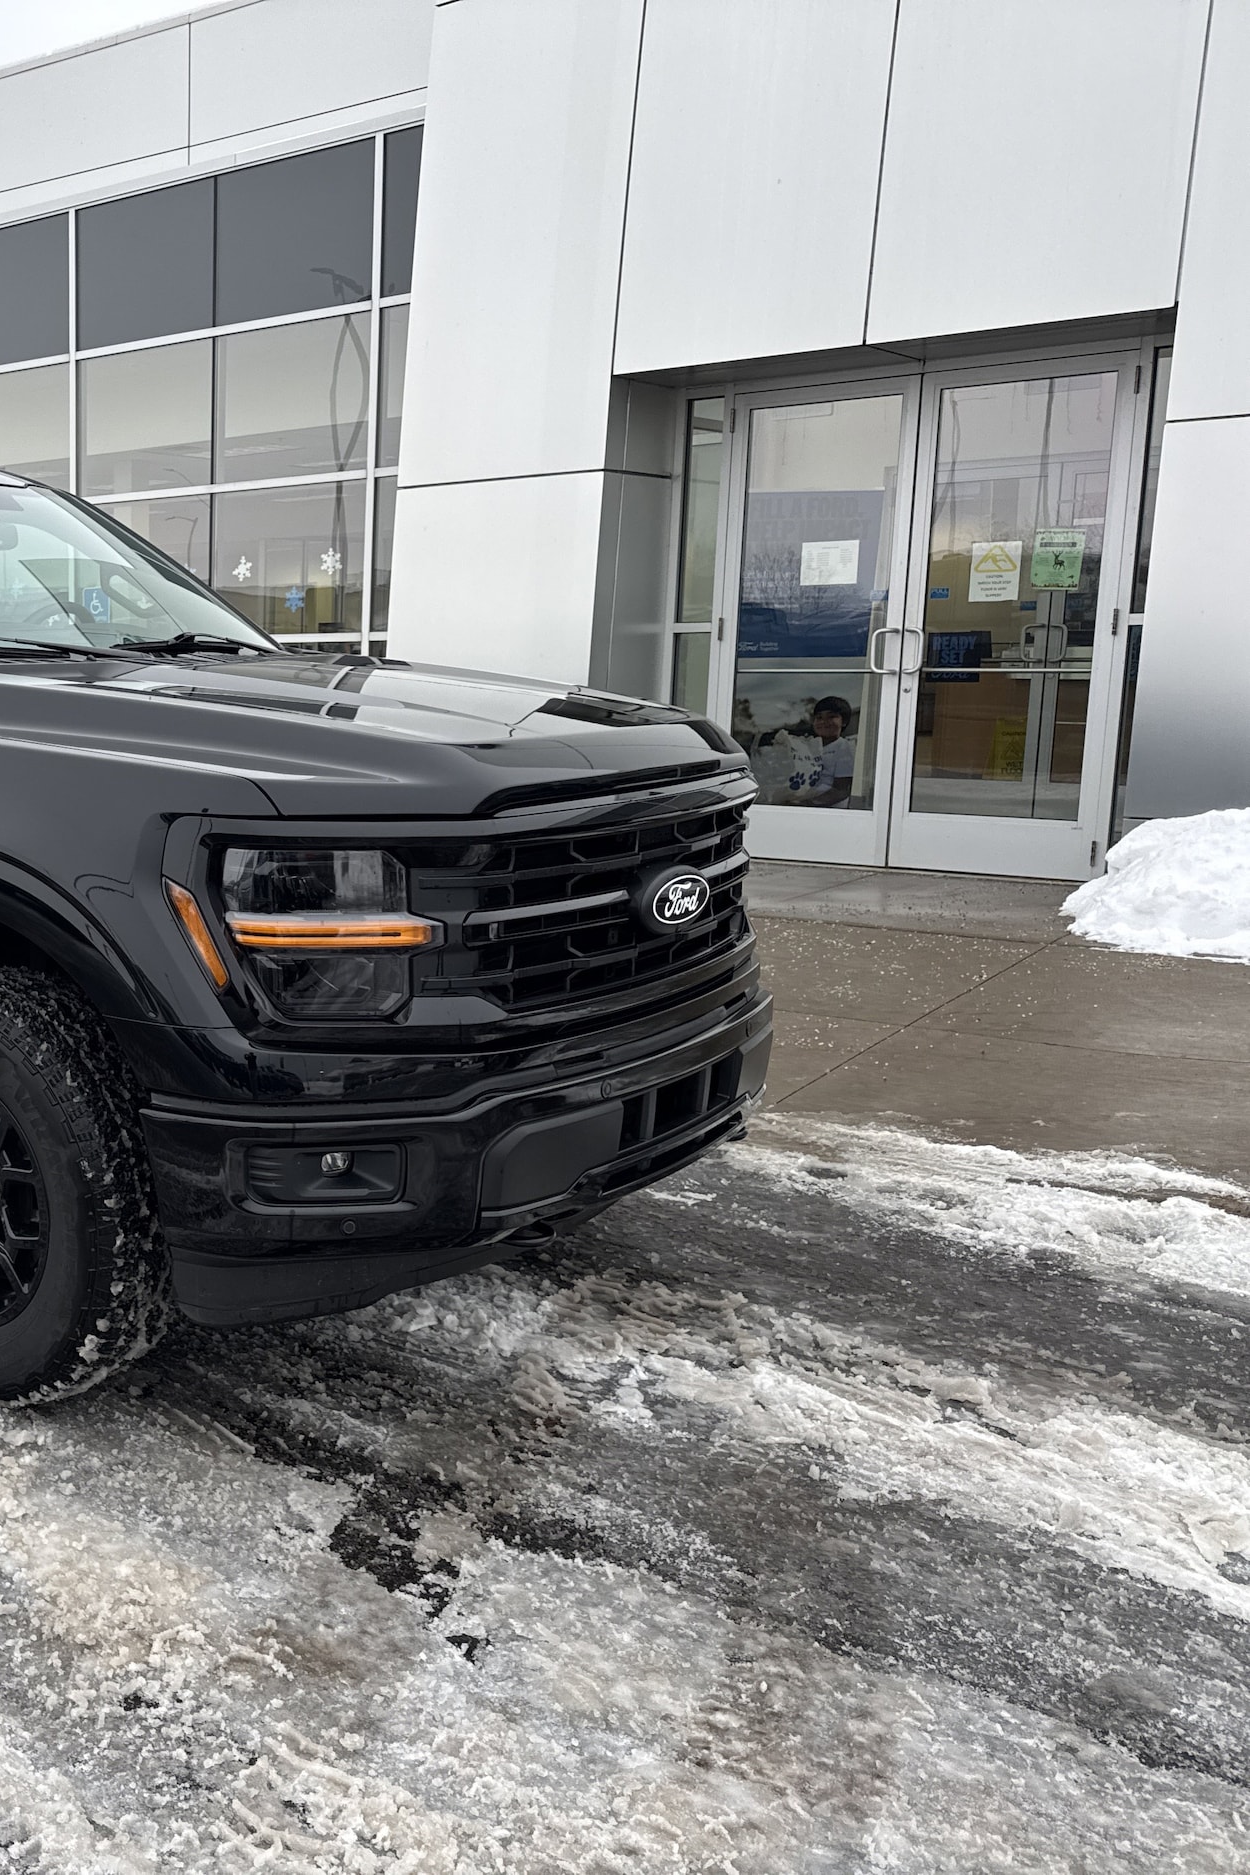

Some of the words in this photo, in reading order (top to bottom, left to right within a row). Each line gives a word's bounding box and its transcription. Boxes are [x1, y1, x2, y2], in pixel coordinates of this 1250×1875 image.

[932, 635, 978, 651] READY
[941, 650, 967, 664] SET
[664, 882, 700, 918] Ford
